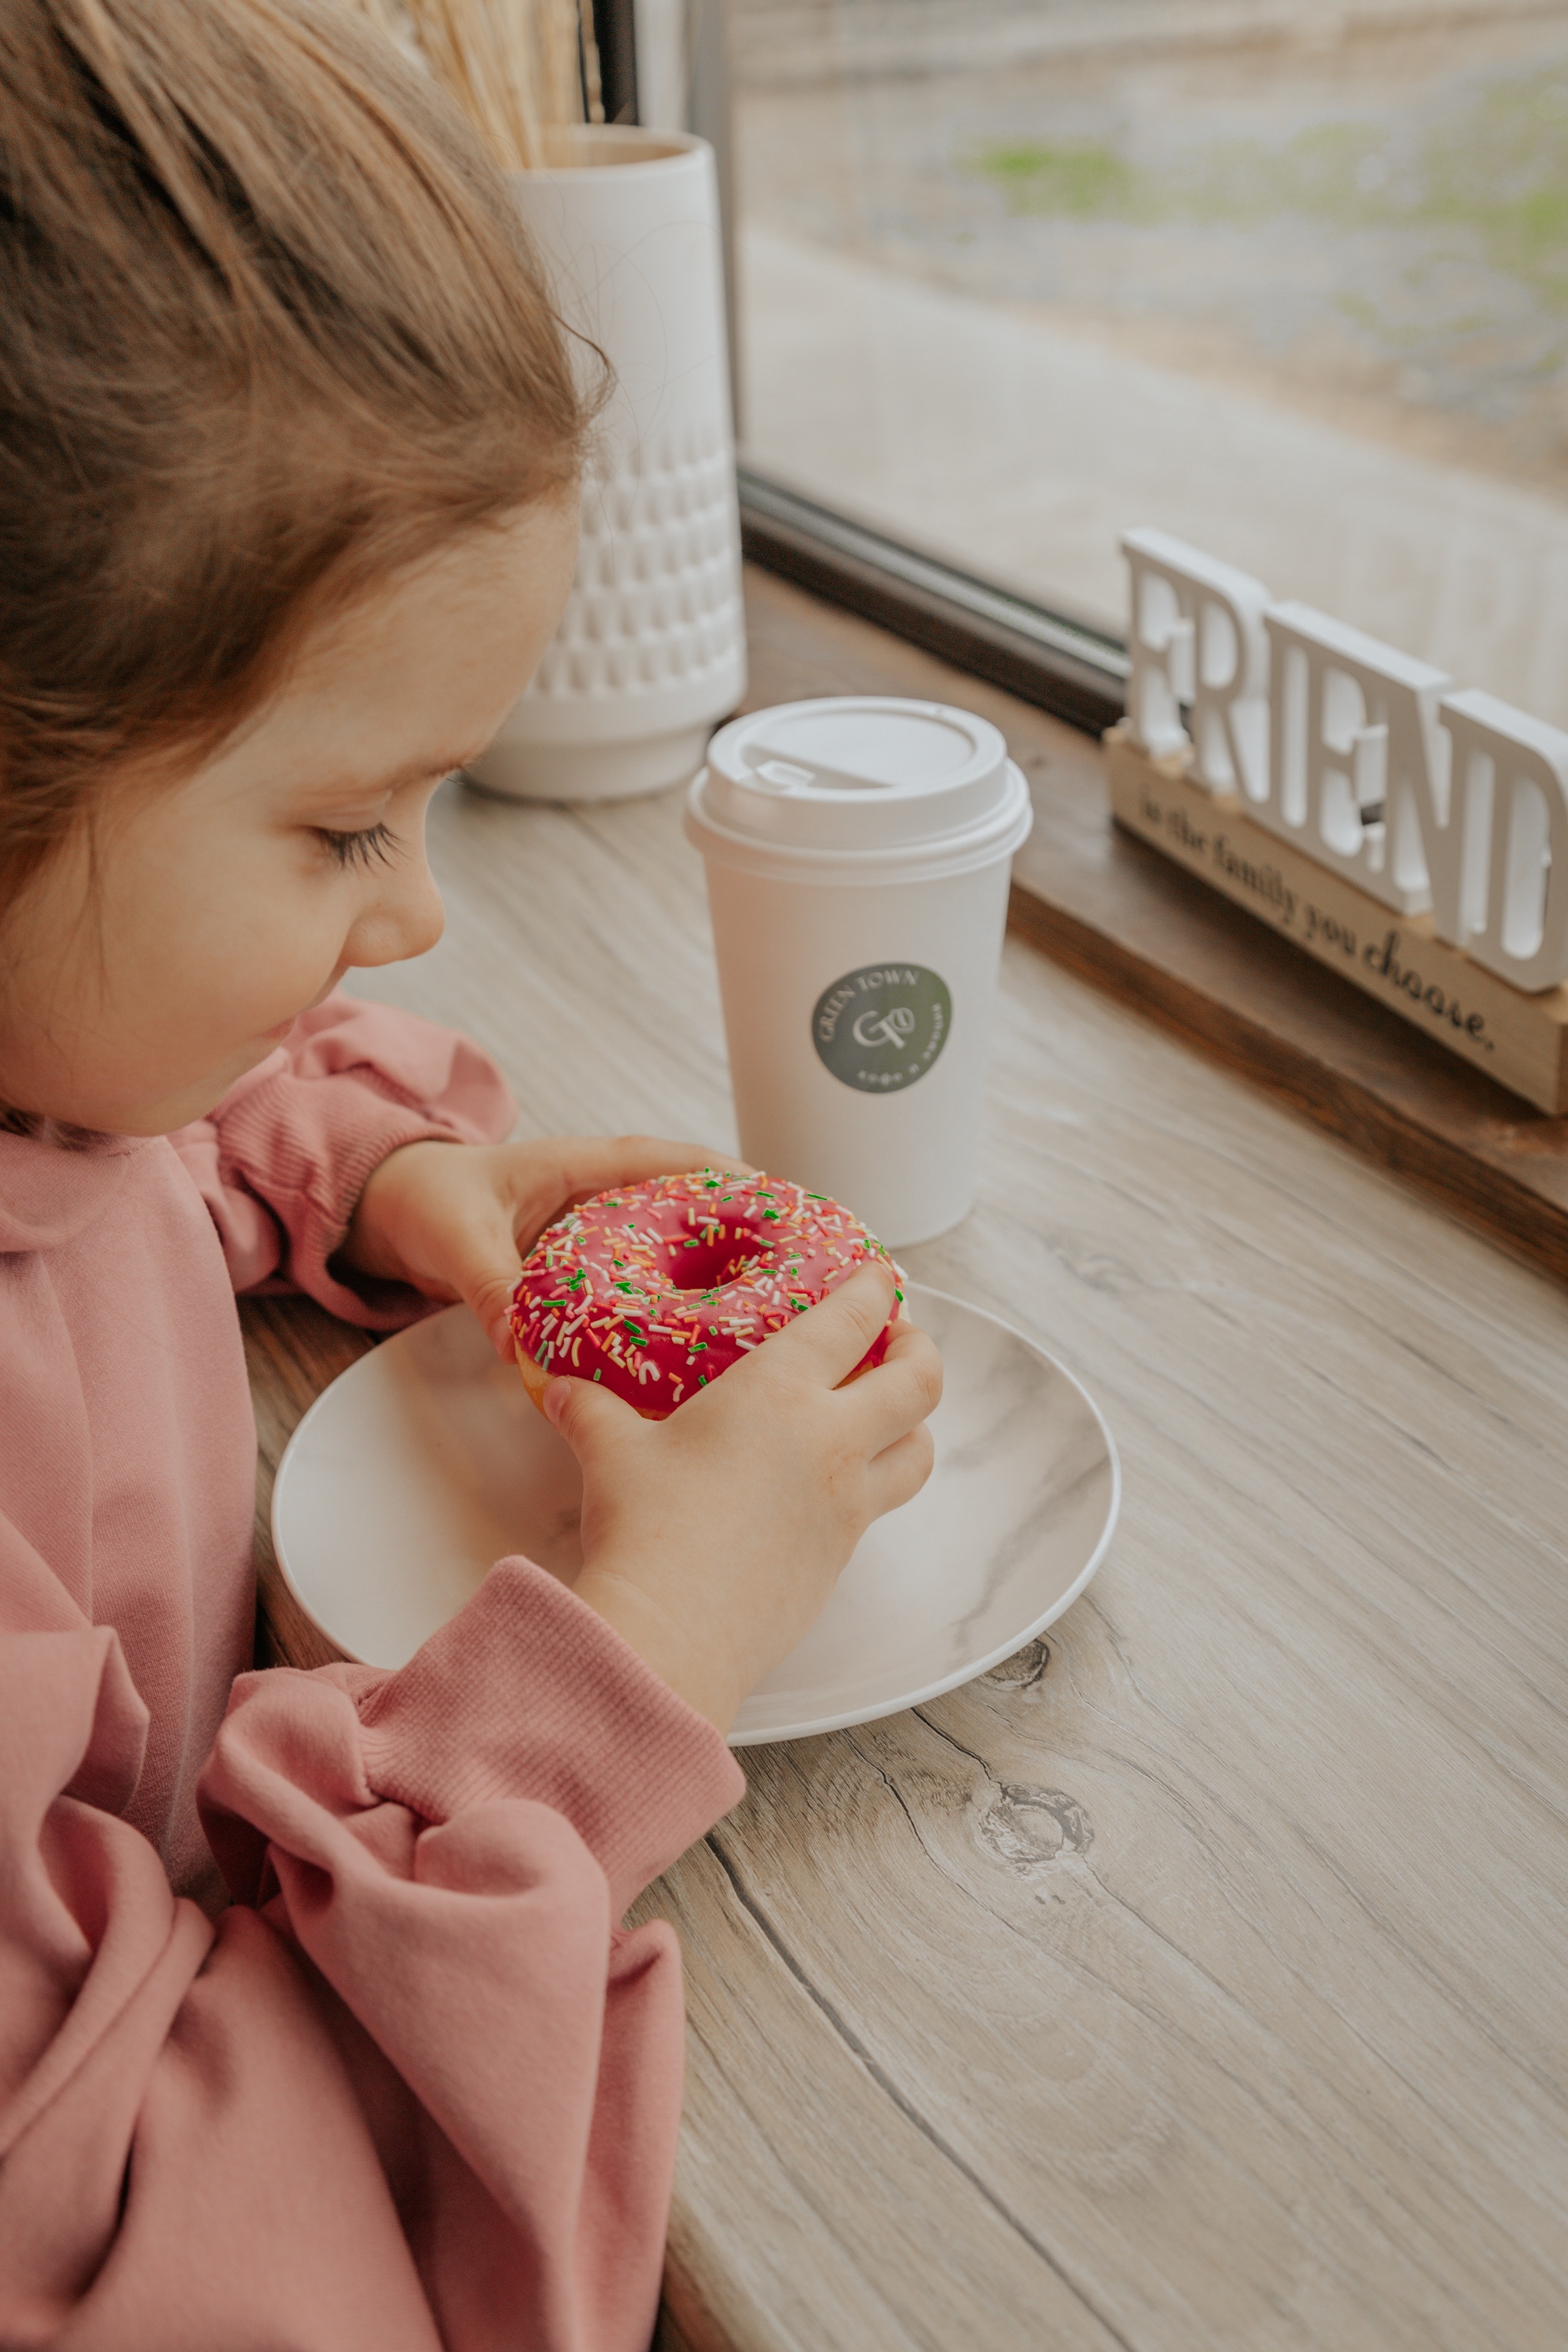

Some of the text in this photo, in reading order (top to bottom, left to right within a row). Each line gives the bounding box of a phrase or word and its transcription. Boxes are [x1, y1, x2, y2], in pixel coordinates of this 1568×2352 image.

[1120, 531, 1568, 994] FRIEND
[1166, 808, 1205, 853] the
[1212, 833, 1300, 924] family
[1306, 904, 1356, 956] you
[819, 970, 920, 1042] GREEN TOWN
